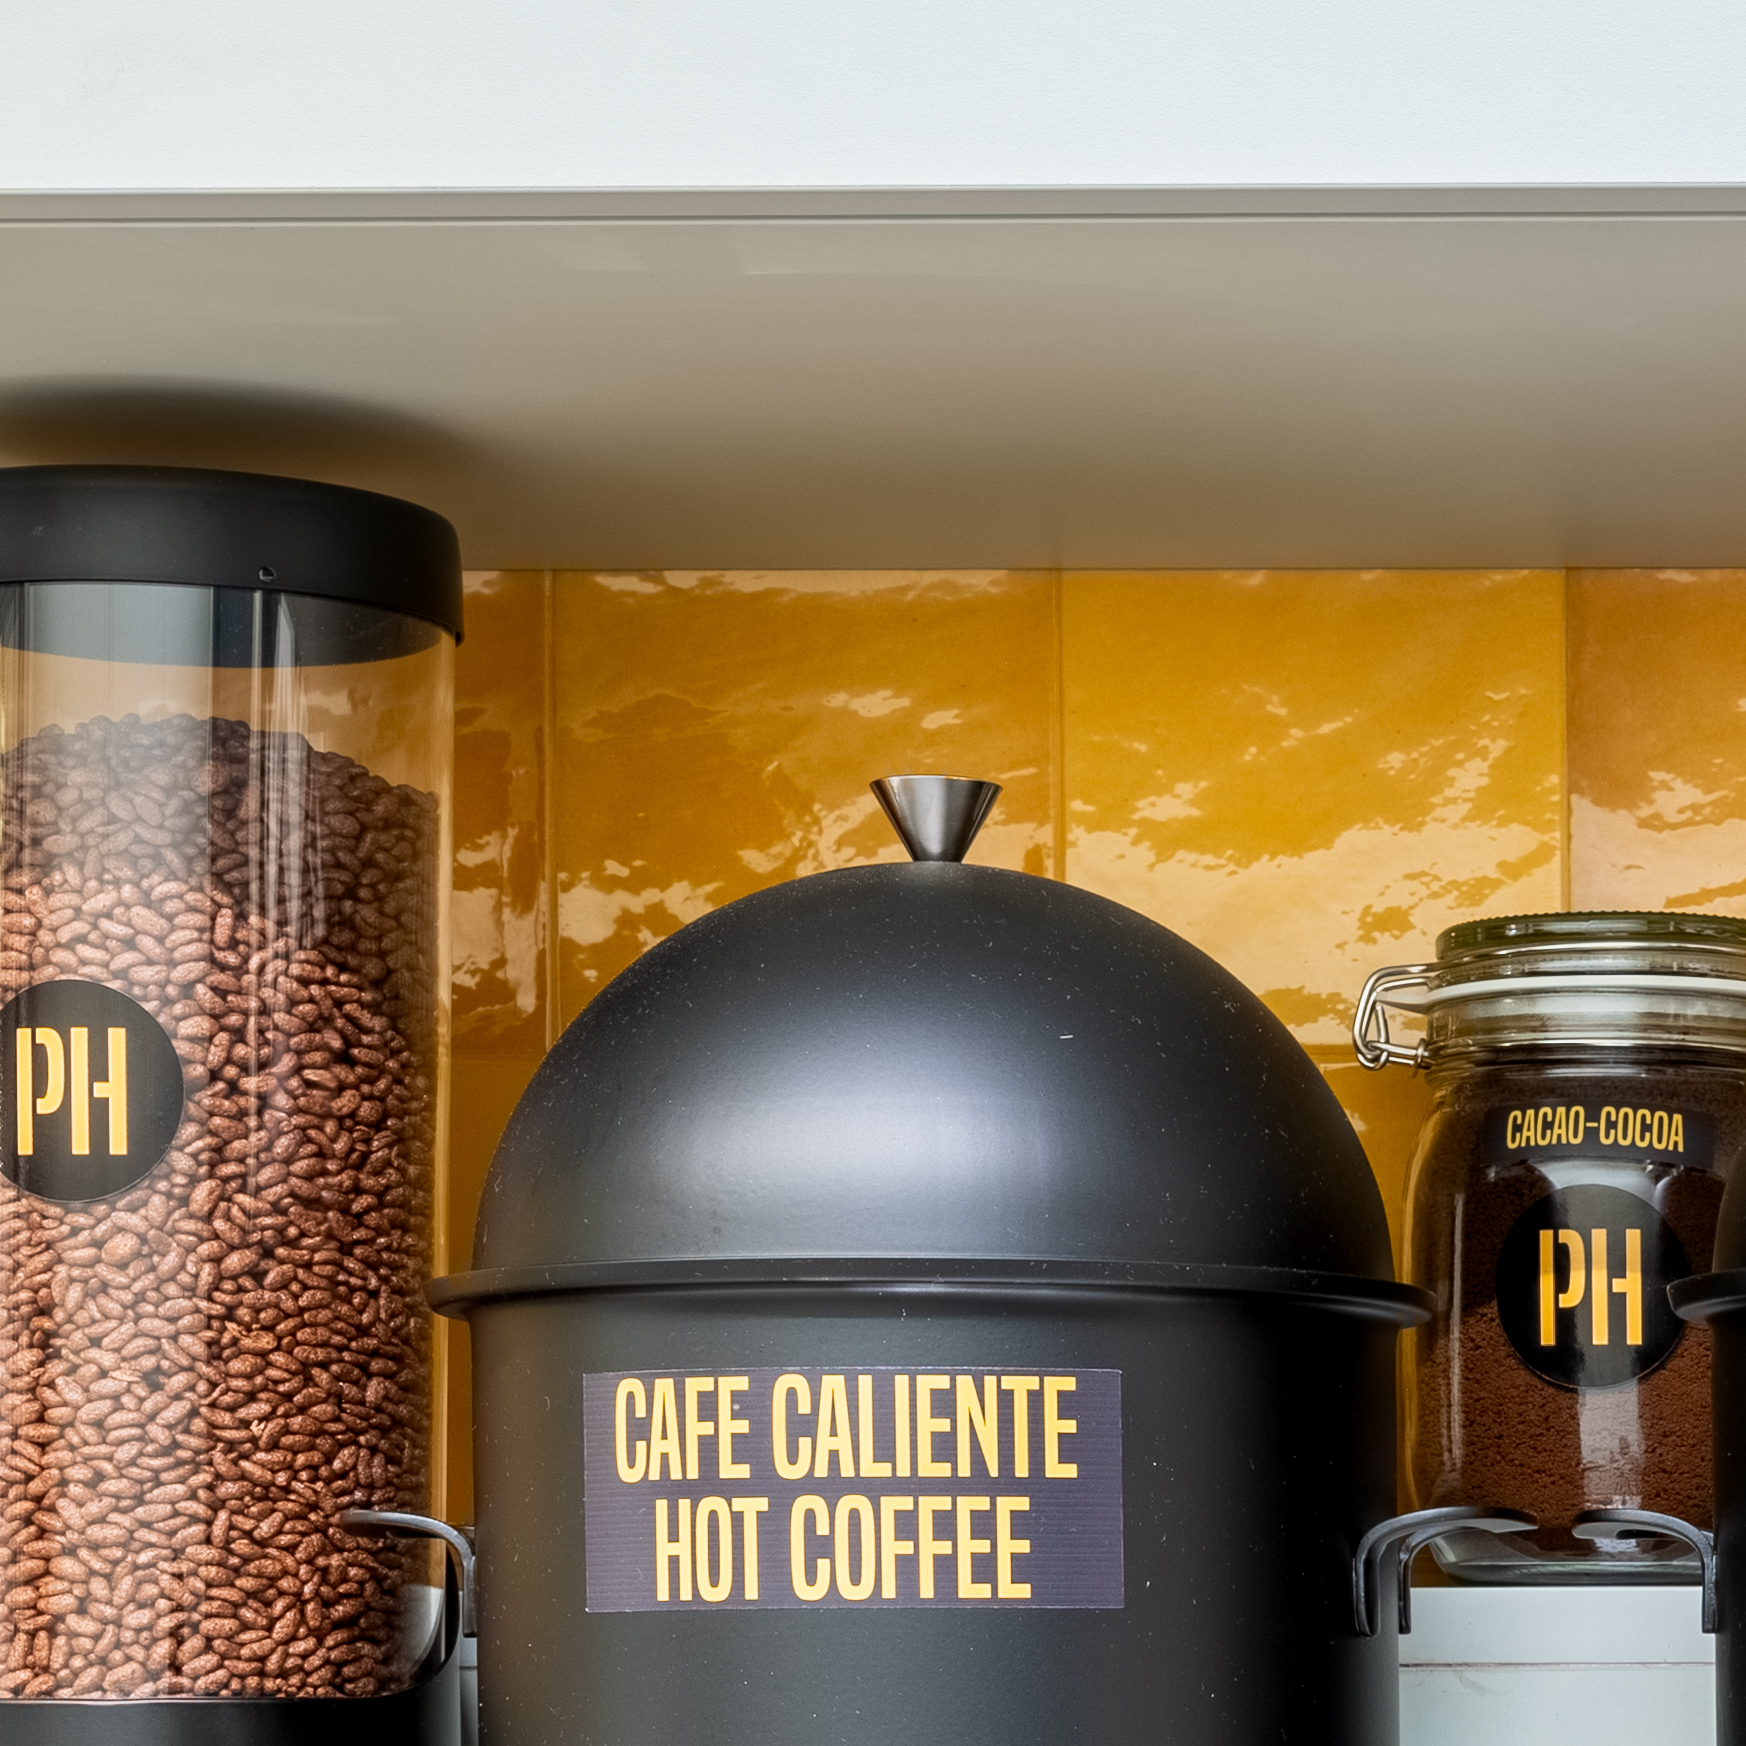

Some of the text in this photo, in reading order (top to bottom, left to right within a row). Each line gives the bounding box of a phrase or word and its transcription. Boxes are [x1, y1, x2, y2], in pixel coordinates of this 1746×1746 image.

[16, 1026, 128, 1156] PH
[1506, 1105, 1684, 1152] CACAO-COCOA
[1539, 1227, 1643, 1346] PH
[614, 1373, 1079, 1483] CAFE CALIENTE
[654, 1494, 1032, 1602] HOT COFFEE
